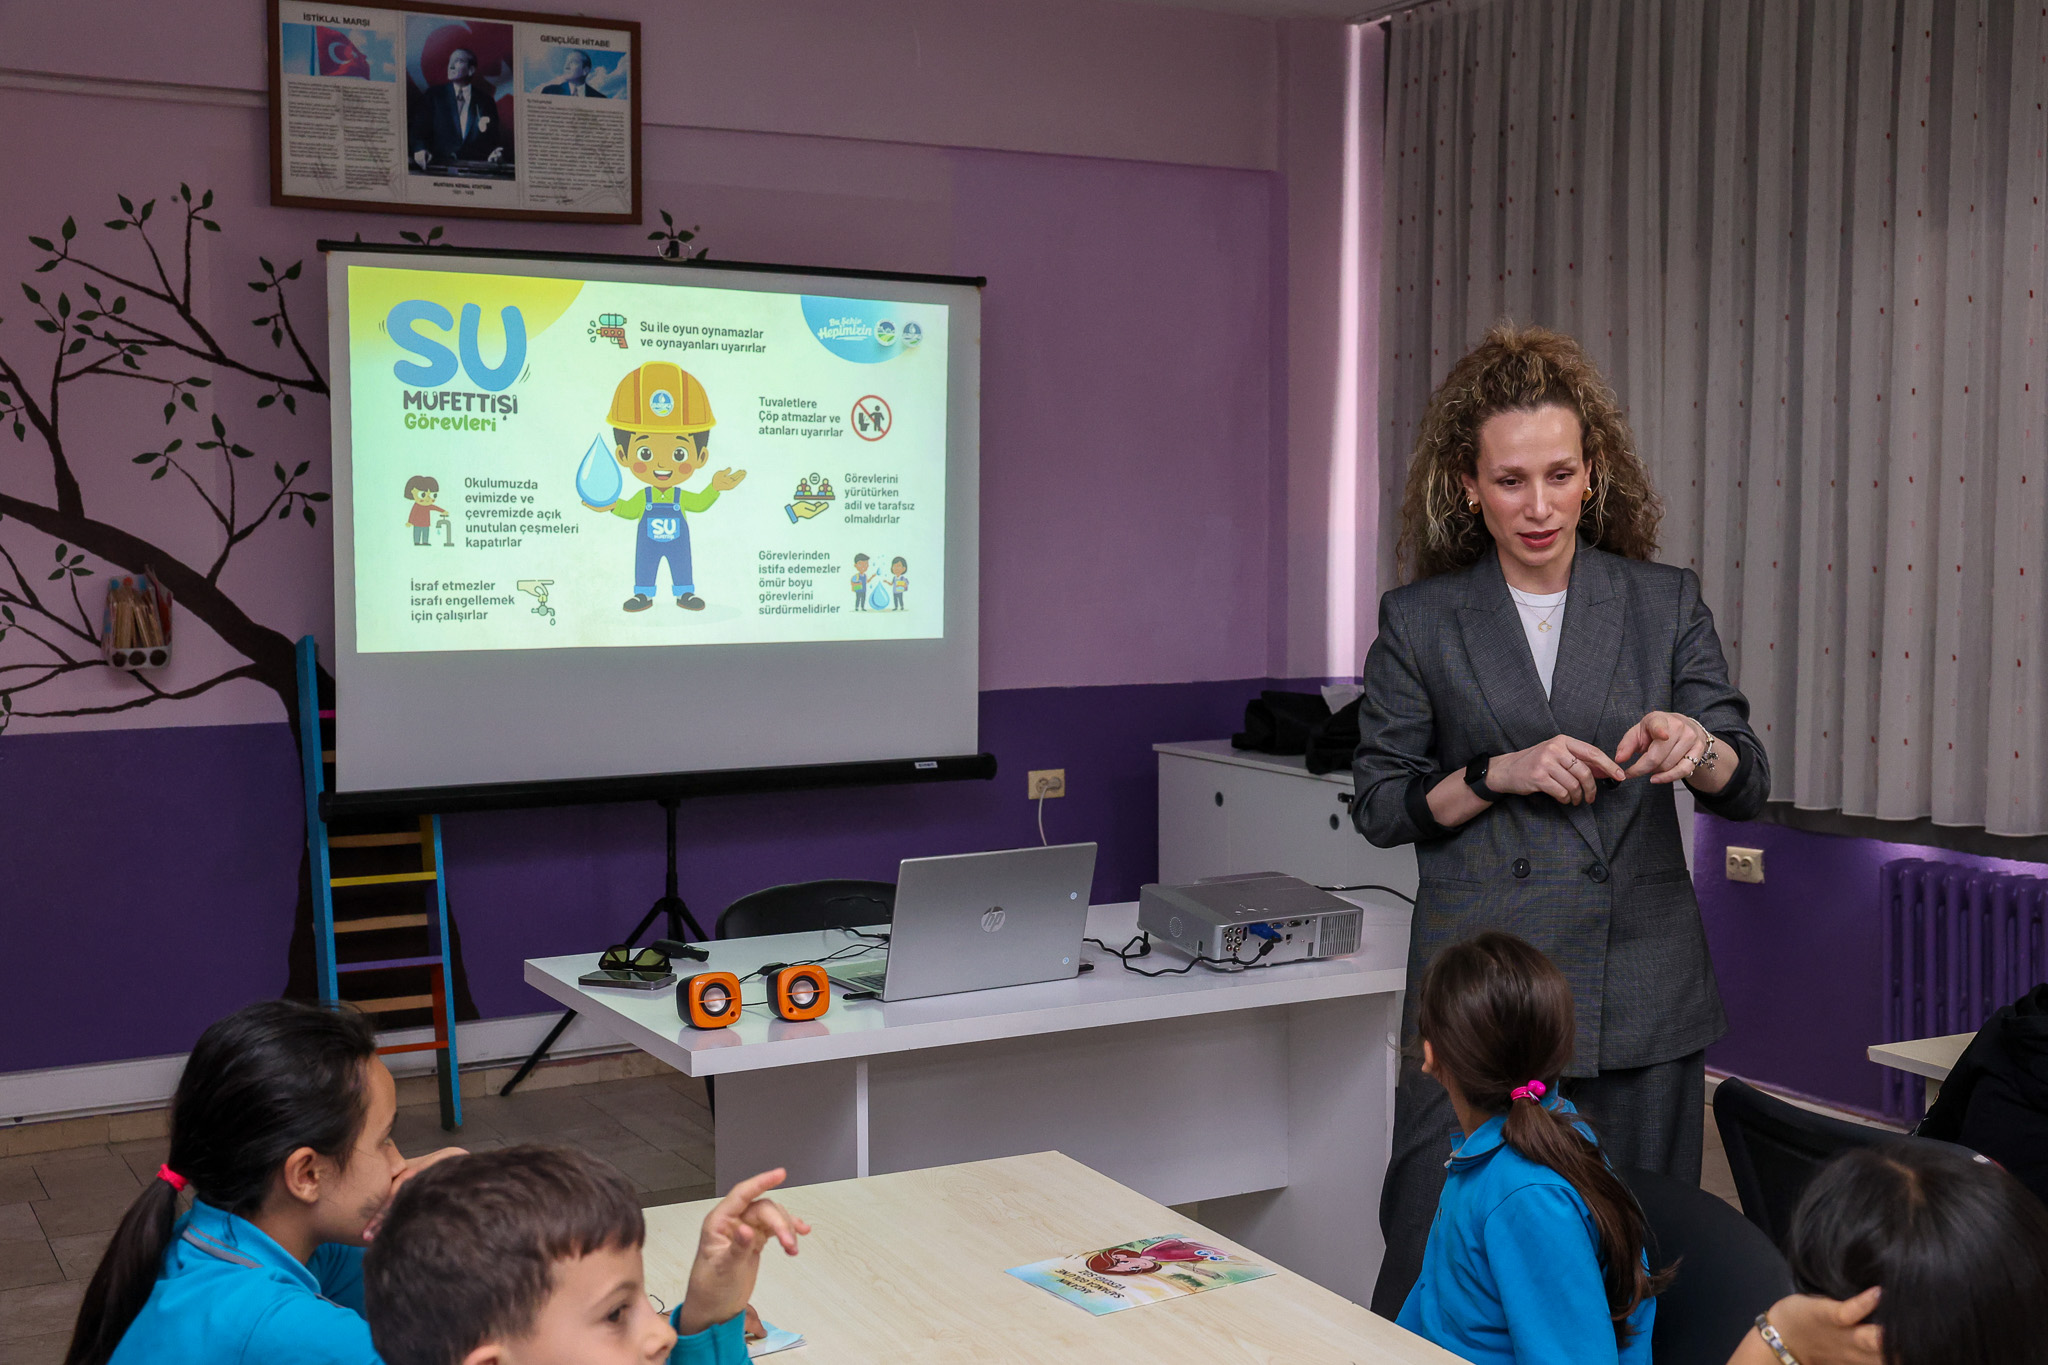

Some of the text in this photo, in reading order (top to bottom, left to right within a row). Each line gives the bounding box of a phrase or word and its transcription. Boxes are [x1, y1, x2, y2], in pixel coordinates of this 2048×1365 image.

[303, 12, 370, 27] İSTİKLAL MARŞI
[540, 34, 610, 48] GENÇLİĞE HİTABE
[640, 321, 763, 339] Su ile oyun oynamazlar
[386, 300, 527, 392] SU
[640, 338, 766, 353] ve oynayanları uyarırlar
[403, 390, 518, 420] MÜFETTİŞİ
[758, 396, 817, 409] Tuvaletlere
[404, 413, 496, 432] Görevleri
[758, 410, 841, 423] Çöp atmazlar ve
[758, 425, 843, 439] atanları uyarırlar
[464, 477, 538, 490] Okulumuzda
[844, 473, 898, 484] Görevlerini
[465, 492, 534, 504] evimizde ve
[844, 487, 899, 499] yürütürken
[844, 500, 915, 511] adil ve tarafsız
[465, 507, 562, 521] çevremizde açık
[844, 514, 900, 524] olmalıdırlar
[465, 522, 579, 535] unutulan çeşmeleri
[651, 518, 677, 535] SU
[465, 536, 522, 550] kapatırlar
[758, 550, 830, 560] Görevlerinden
[758, 564, 841, 574] istifa edemezler
[410, 578, 496, 591] İsraf etmezler
[758, 577, 813, 589] ömür boyu
[410, 595, 515, 608] israfı engellemek
[758, 591, 814, 603] görevlerini
[758, 604, 840, 615] sürdürmelidirler
[411, 610, 488, 623] için çalışırlar
[981, 906, 1005, 933] hp
